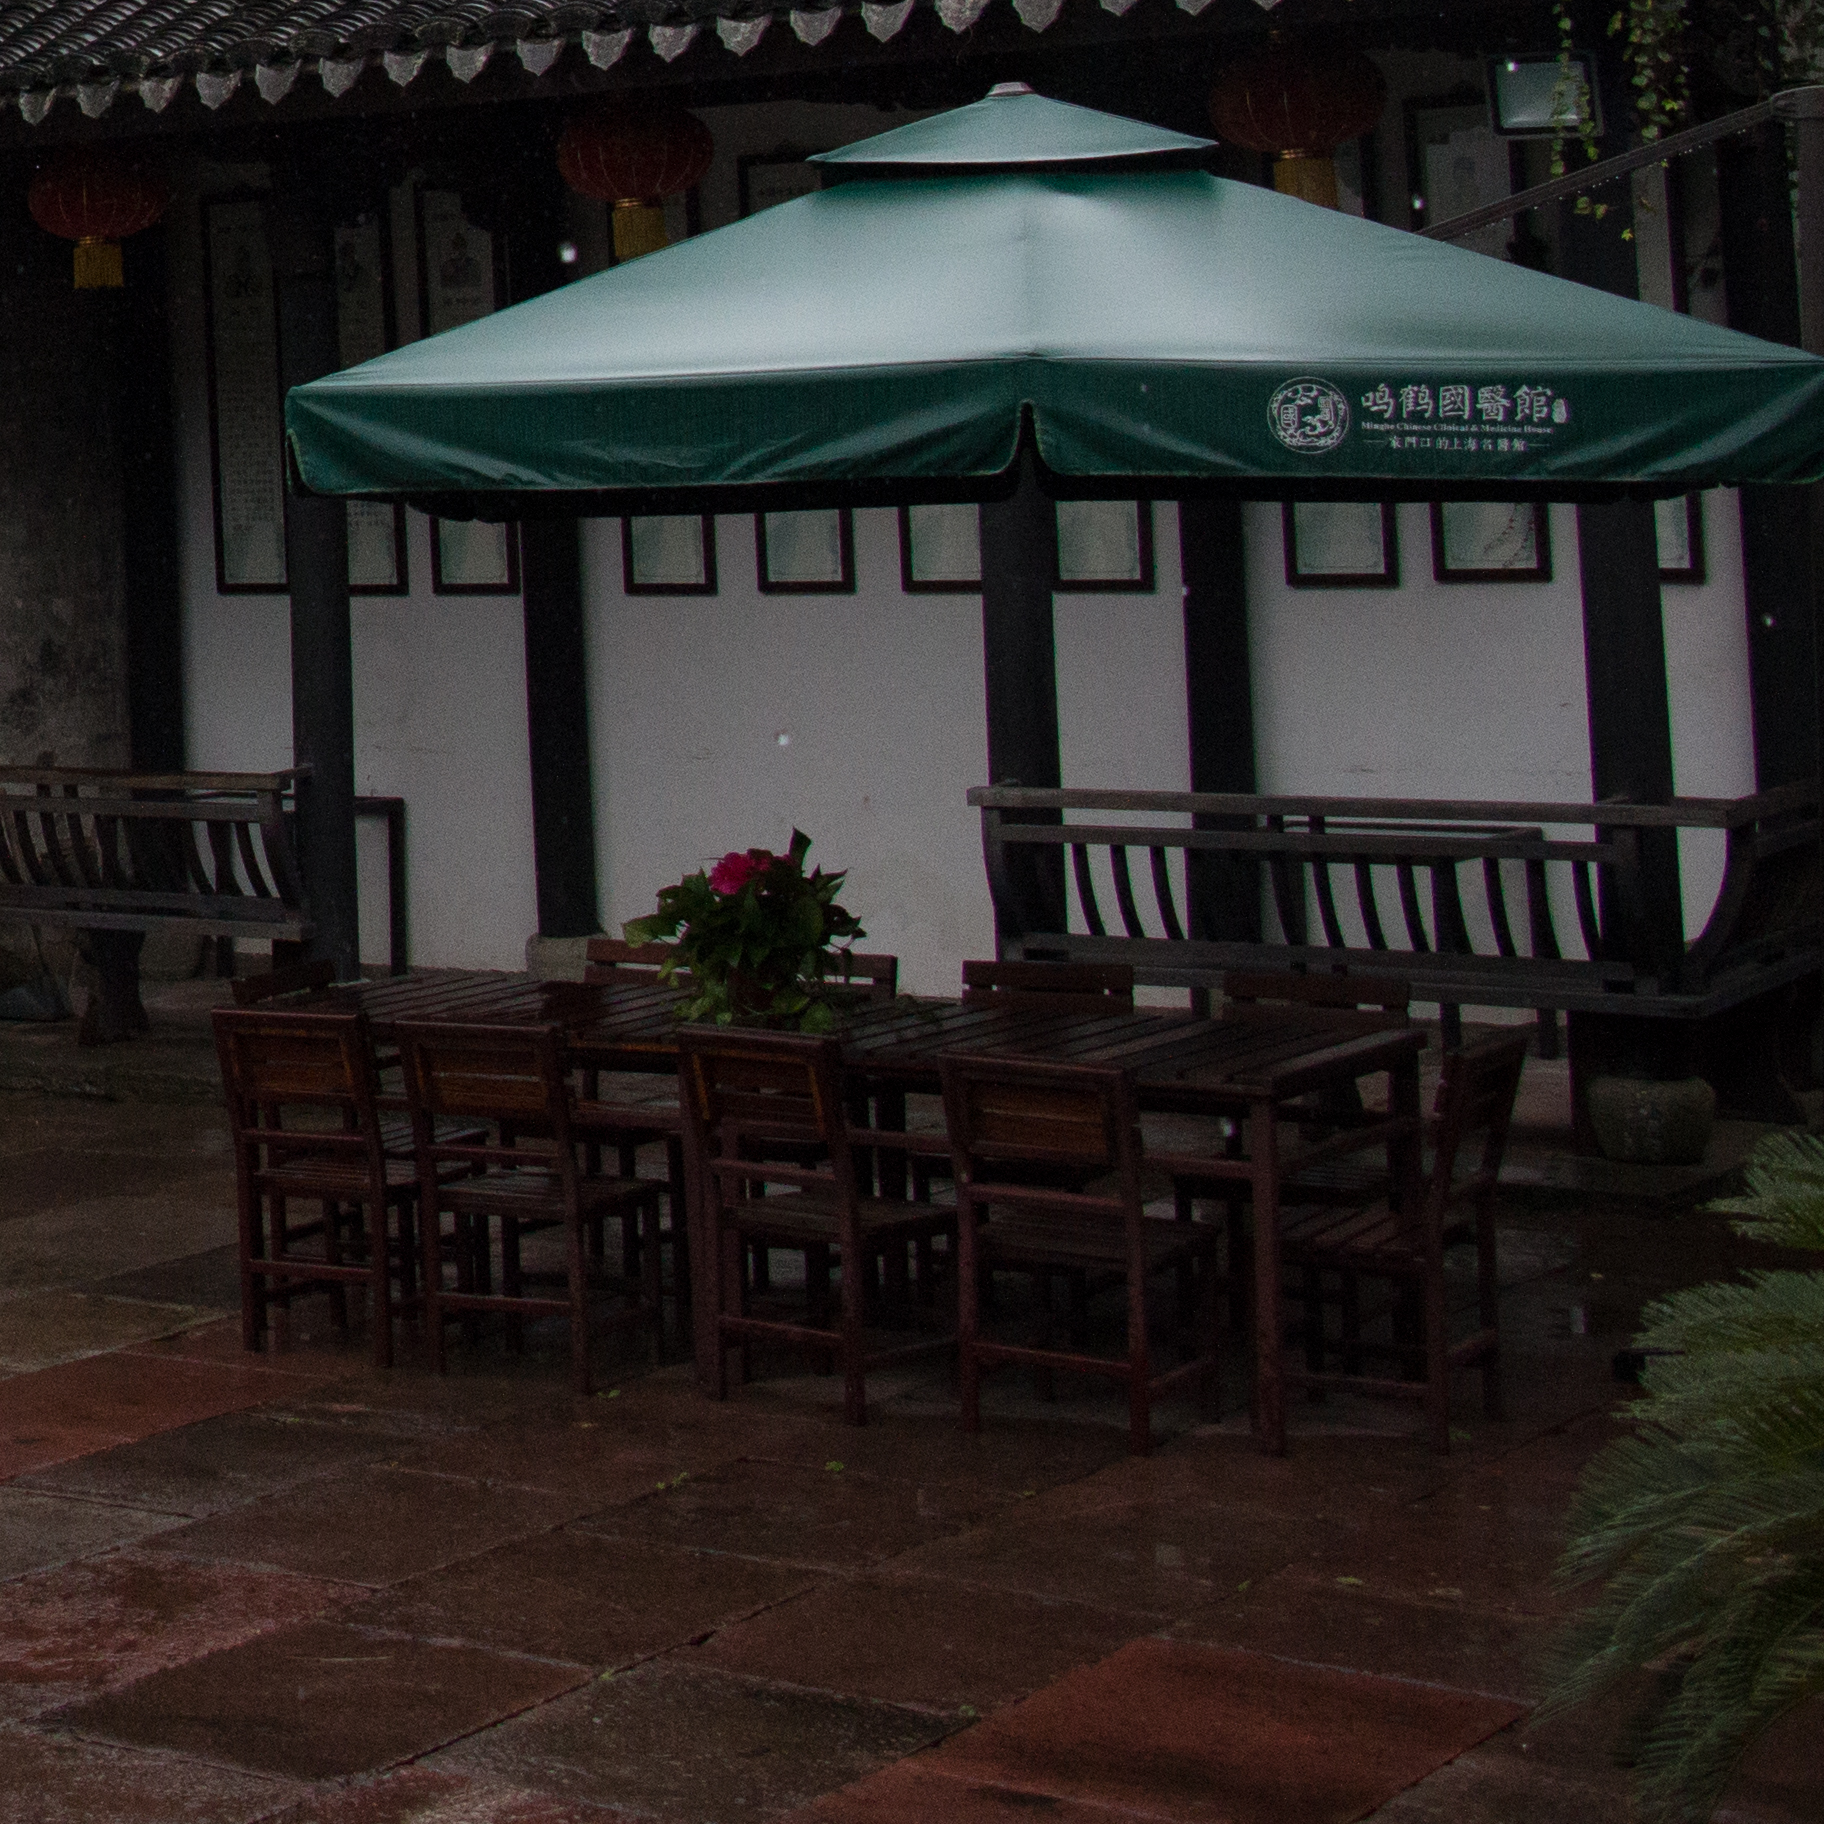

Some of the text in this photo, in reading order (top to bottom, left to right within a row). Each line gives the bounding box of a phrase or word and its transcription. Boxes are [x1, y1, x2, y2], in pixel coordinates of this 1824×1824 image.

[1361, 383, 1555, 423] 鸣鹤國醫館
[1396, 422, 1432, 432] Chinese
[1481, 423, 1523, 434] Medicine
[1524, 424, 1555, 435] House
